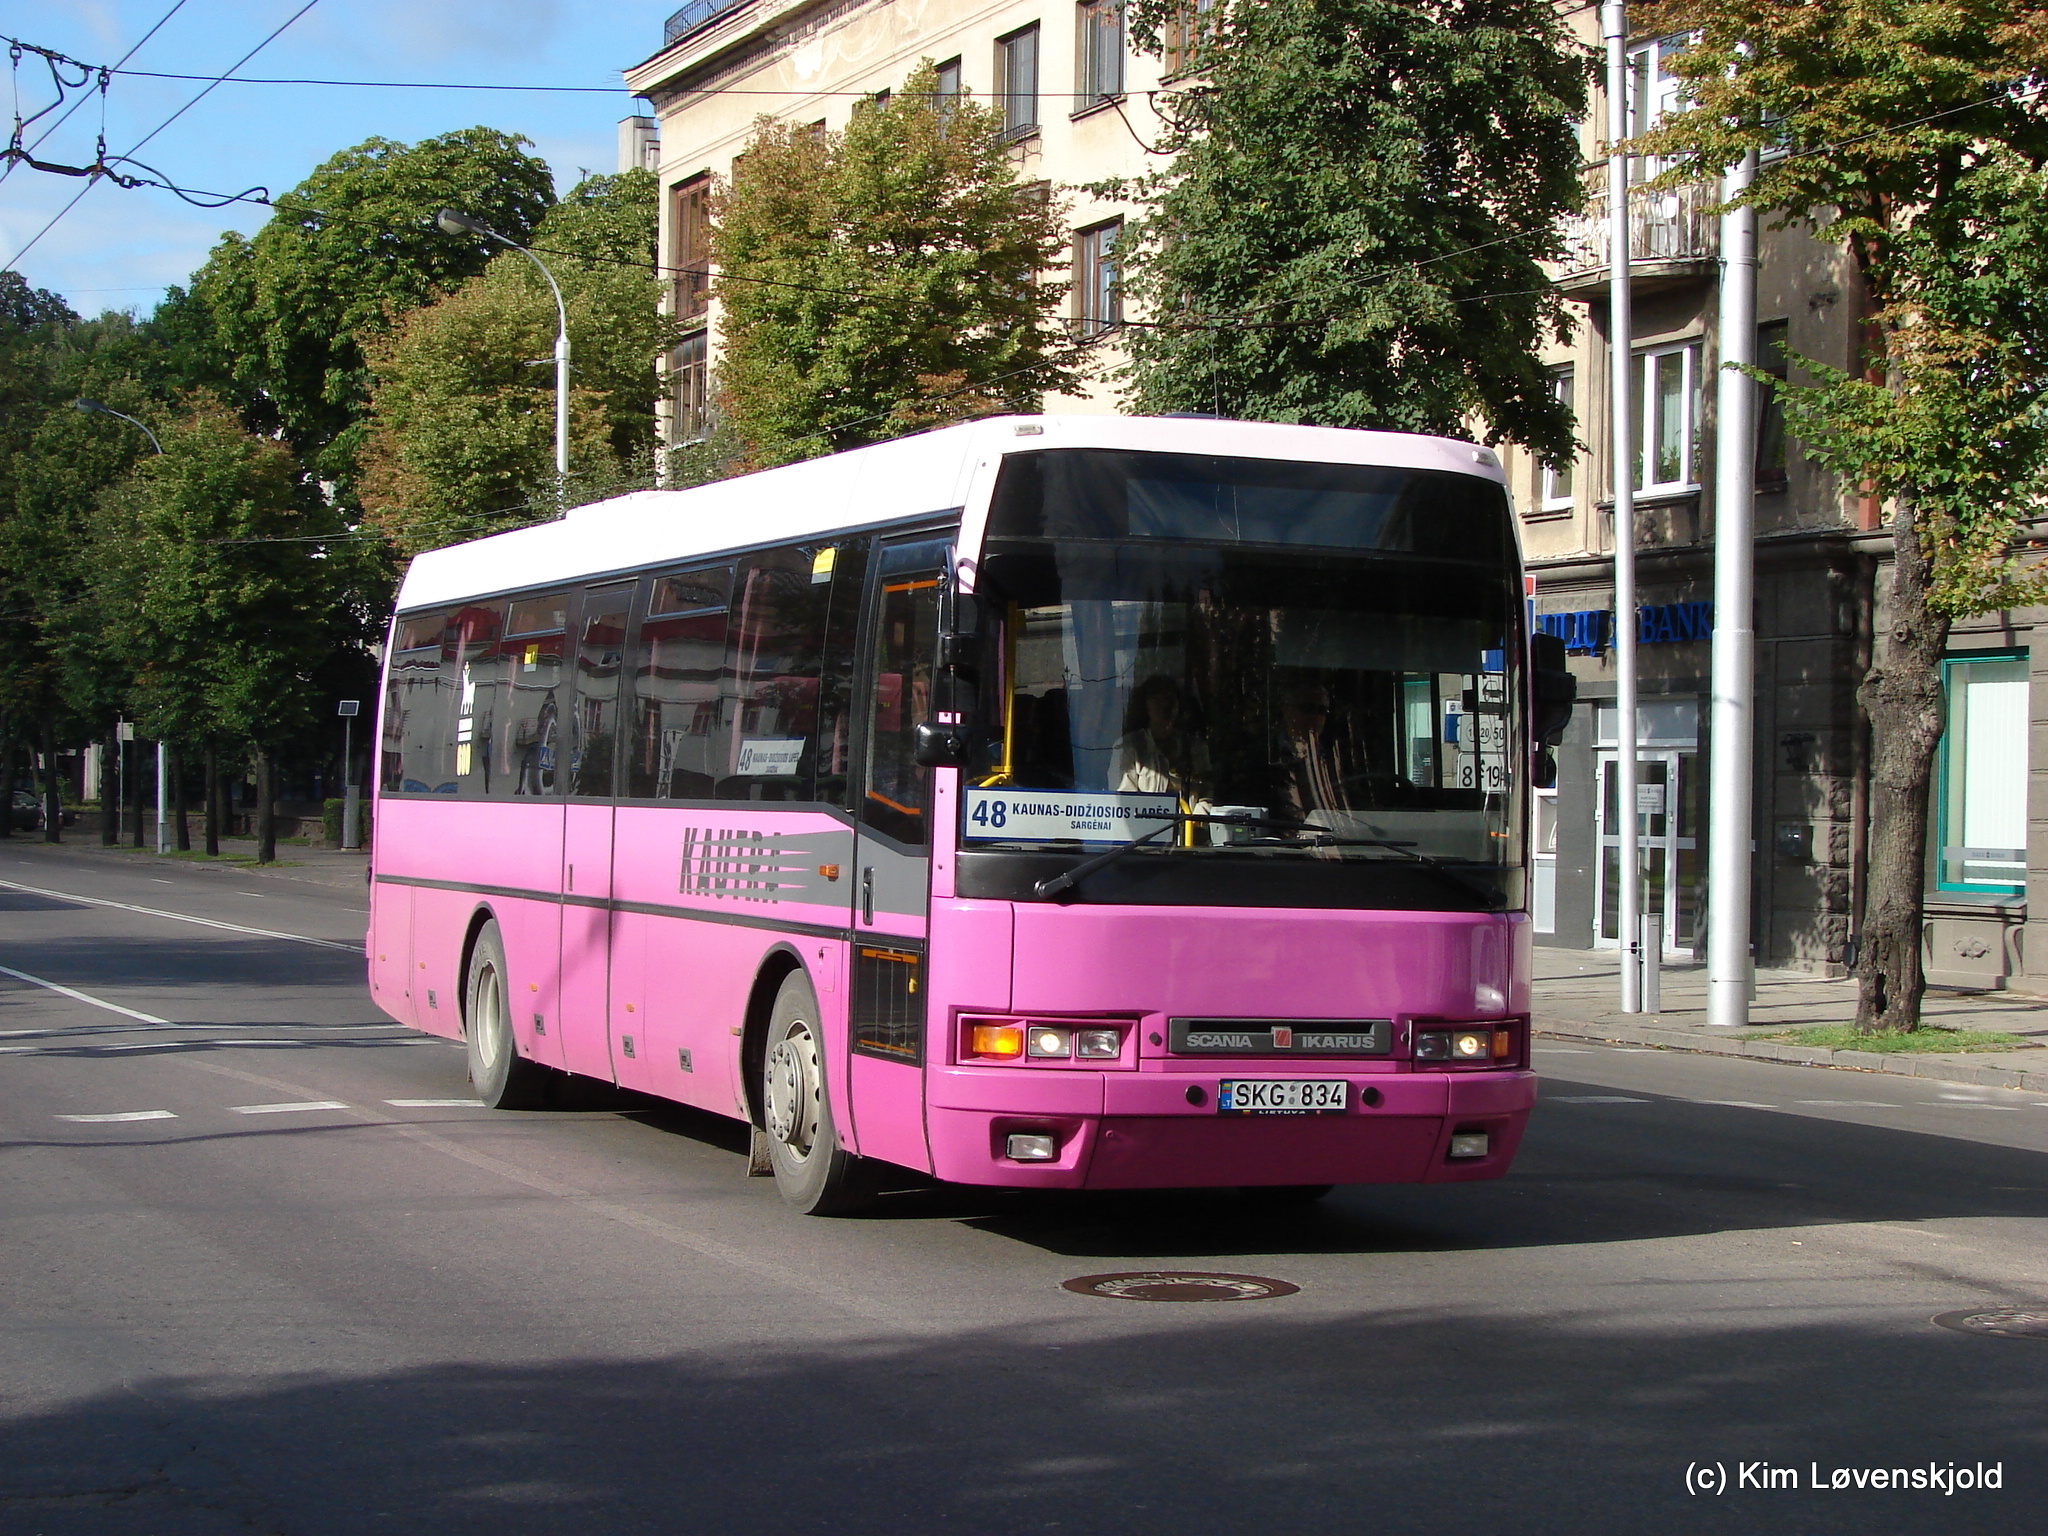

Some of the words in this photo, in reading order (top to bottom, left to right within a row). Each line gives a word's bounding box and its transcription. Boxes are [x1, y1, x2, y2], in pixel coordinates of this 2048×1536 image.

[1638, 602, 1714, 643] BANK
[1480, 727, 1490, 738] 20
[1493, 727, 1504, 740] 50
[739, 748, 753, 771] 48
[1462, 766, 1473, 787] 8
[971, 799, 1007, 828] 48
[1012, 803, 1131, 819] KAUNAS-DIDŽIOSIOS
[1070, 819, 1112, 831] SARGĖNAI
[1186, 1035, 1253, 1048] SCANIA
[1302, 1036, 1375, 1049] IKARUS
[1235, 1083, 1285, 1107] SKG
[1301, 1083, 1343, 1107] 834
